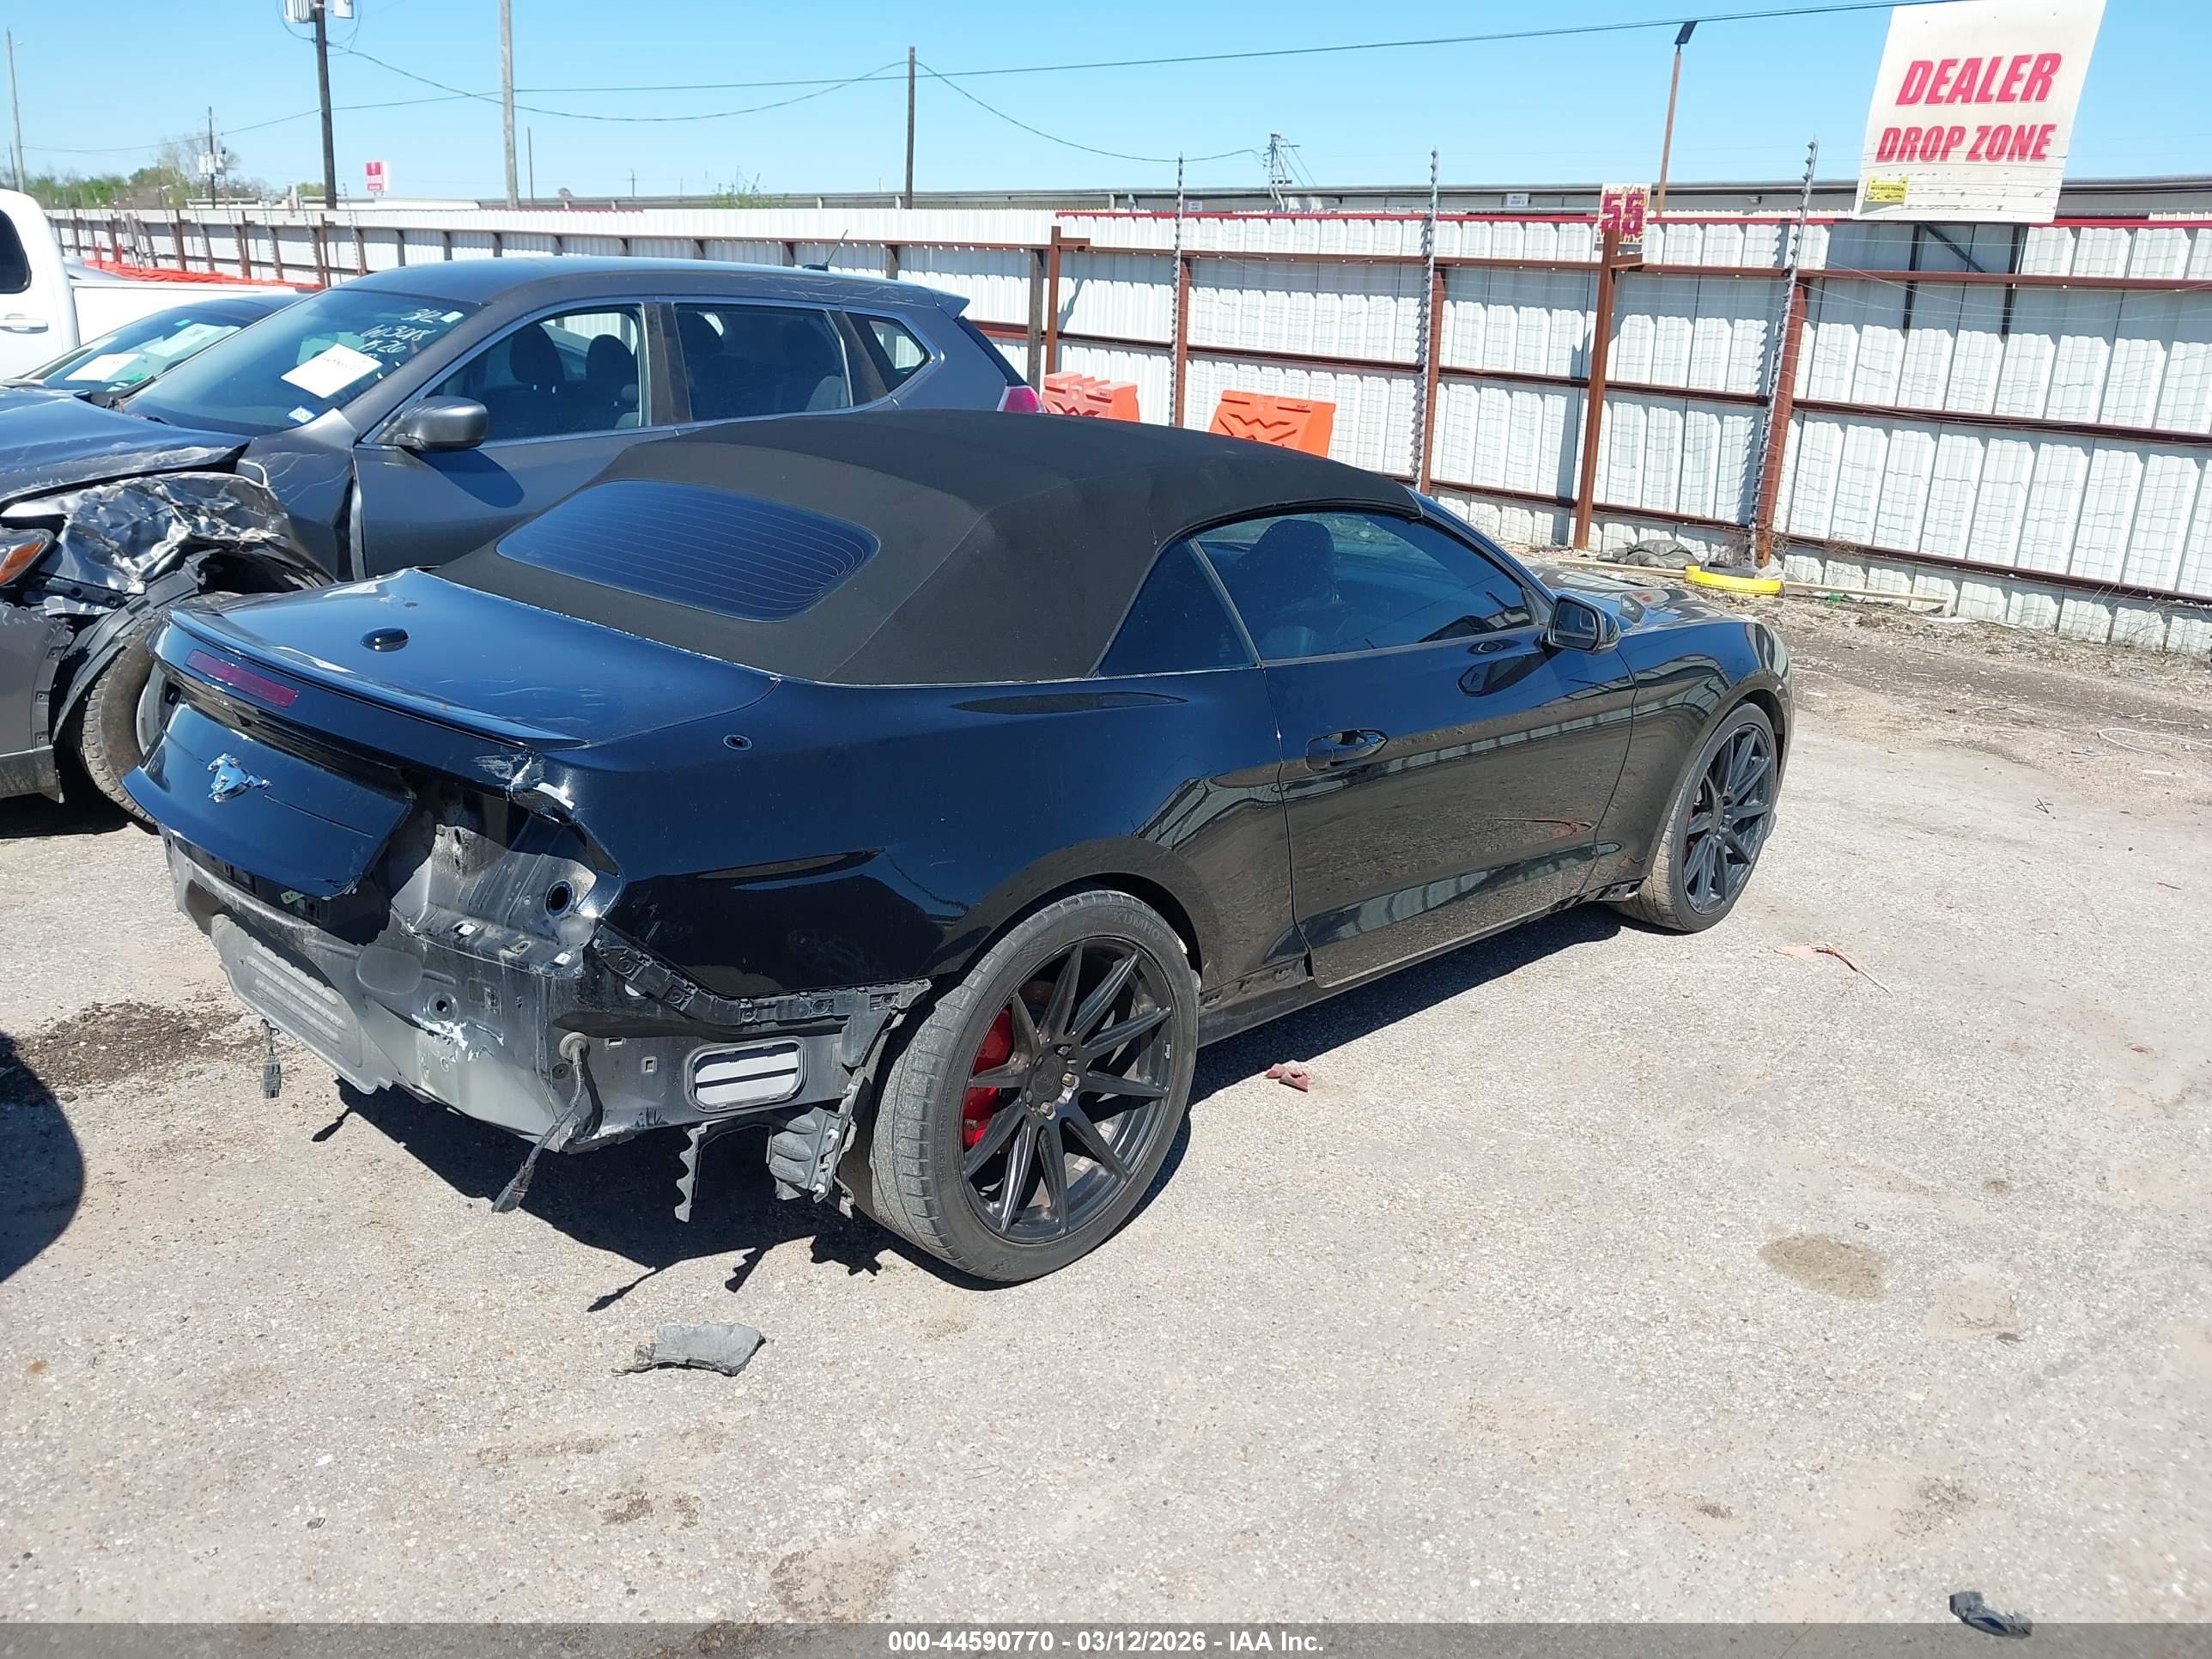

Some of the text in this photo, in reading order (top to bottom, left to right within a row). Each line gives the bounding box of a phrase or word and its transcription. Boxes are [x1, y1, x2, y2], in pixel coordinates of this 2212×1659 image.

[1895, 52, 2063, 106] DEALER
[1875, 124, 2058, 163] DROP ZONE
[1112, 910, 1160, 940] KUMHO
